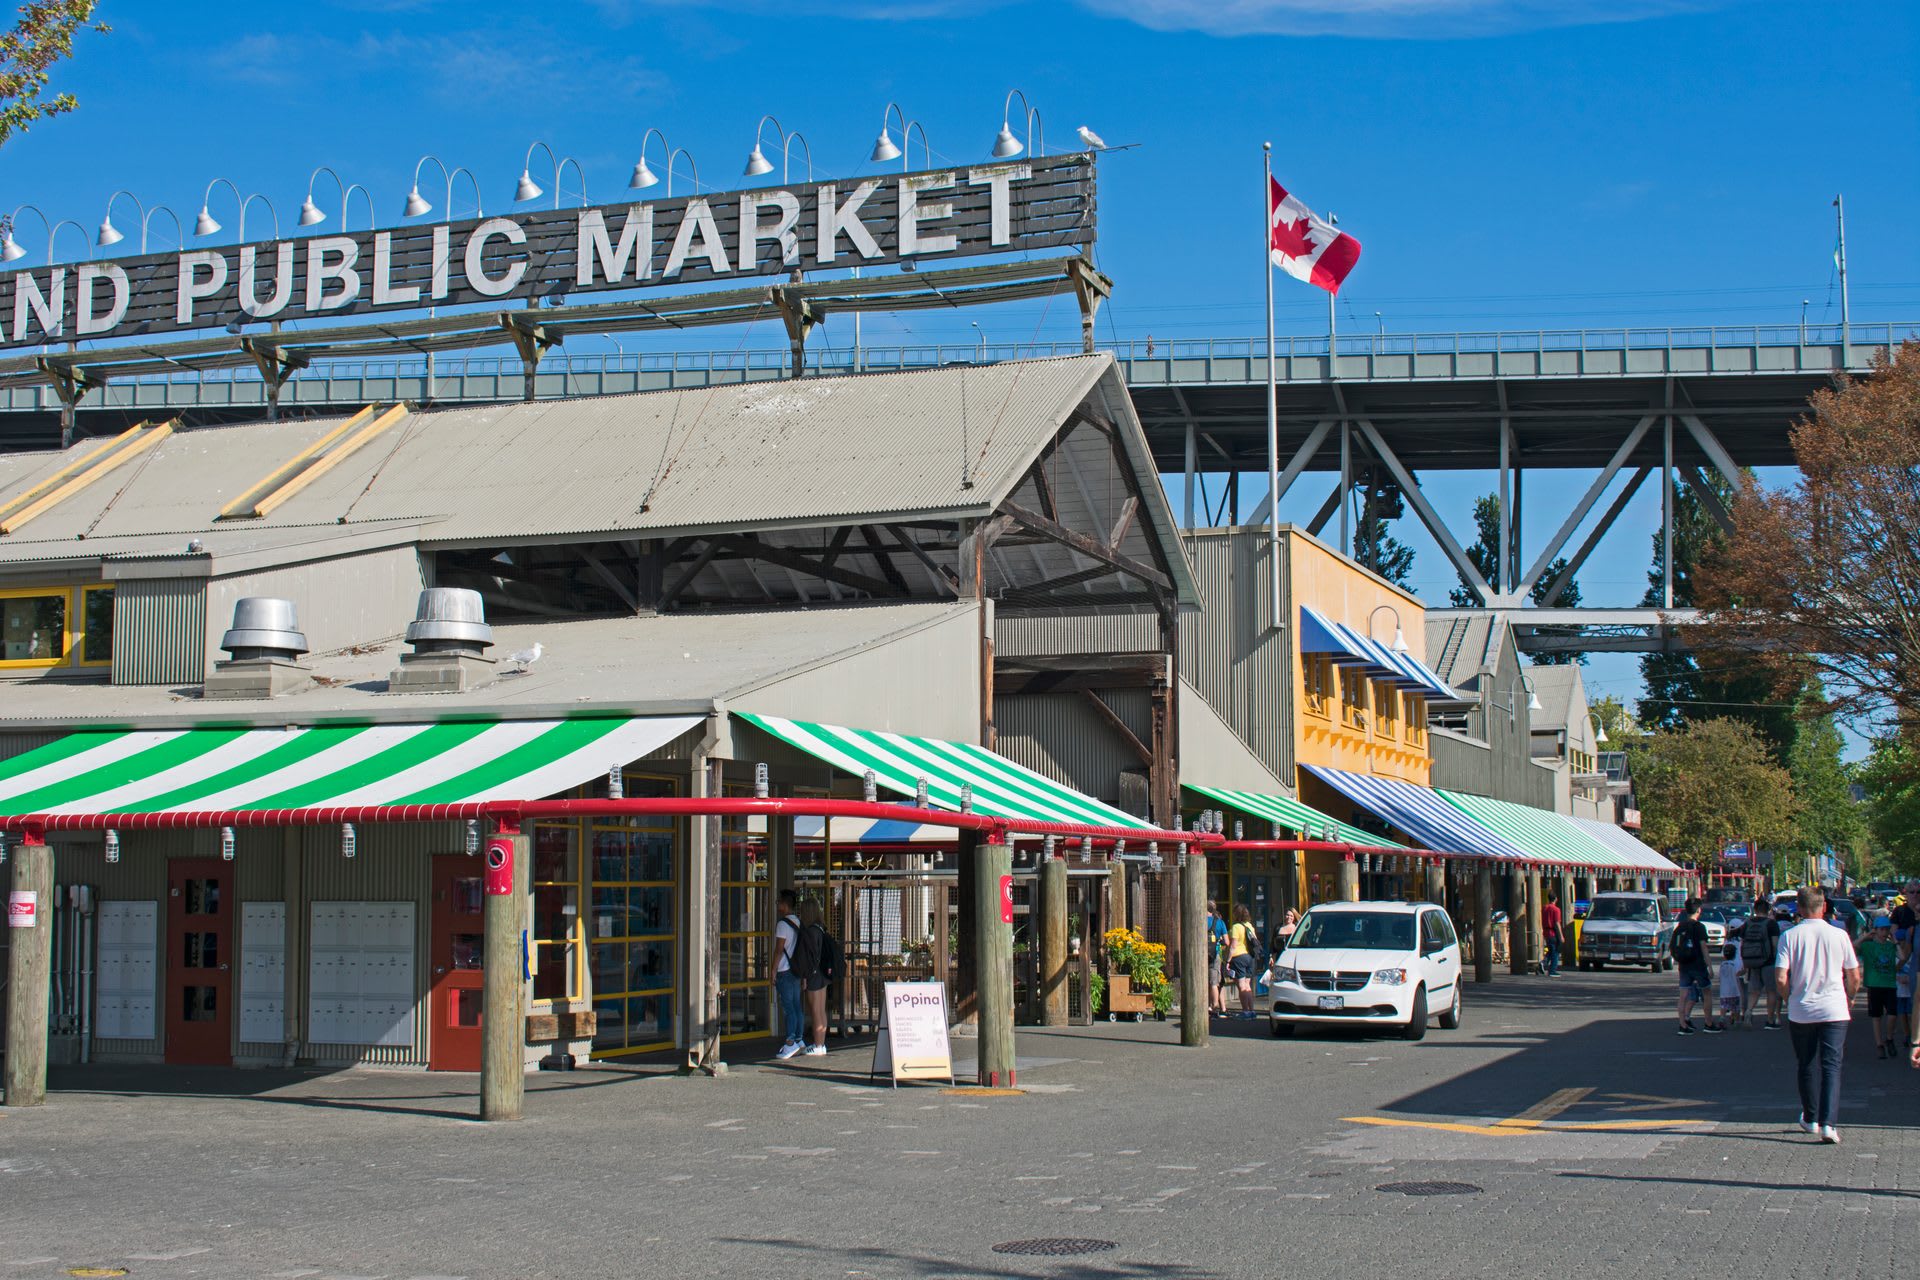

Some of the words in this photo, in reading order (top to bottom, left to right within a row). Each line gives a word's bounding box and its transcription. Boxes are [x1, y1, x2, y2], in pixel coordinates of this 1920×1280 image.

[0, 263, 131, 342] ND
[176, 217, 528, 325] PUBLIC
[576, 163, 1032, 286] MARKET
[893, 992, 940, 1009] popina
